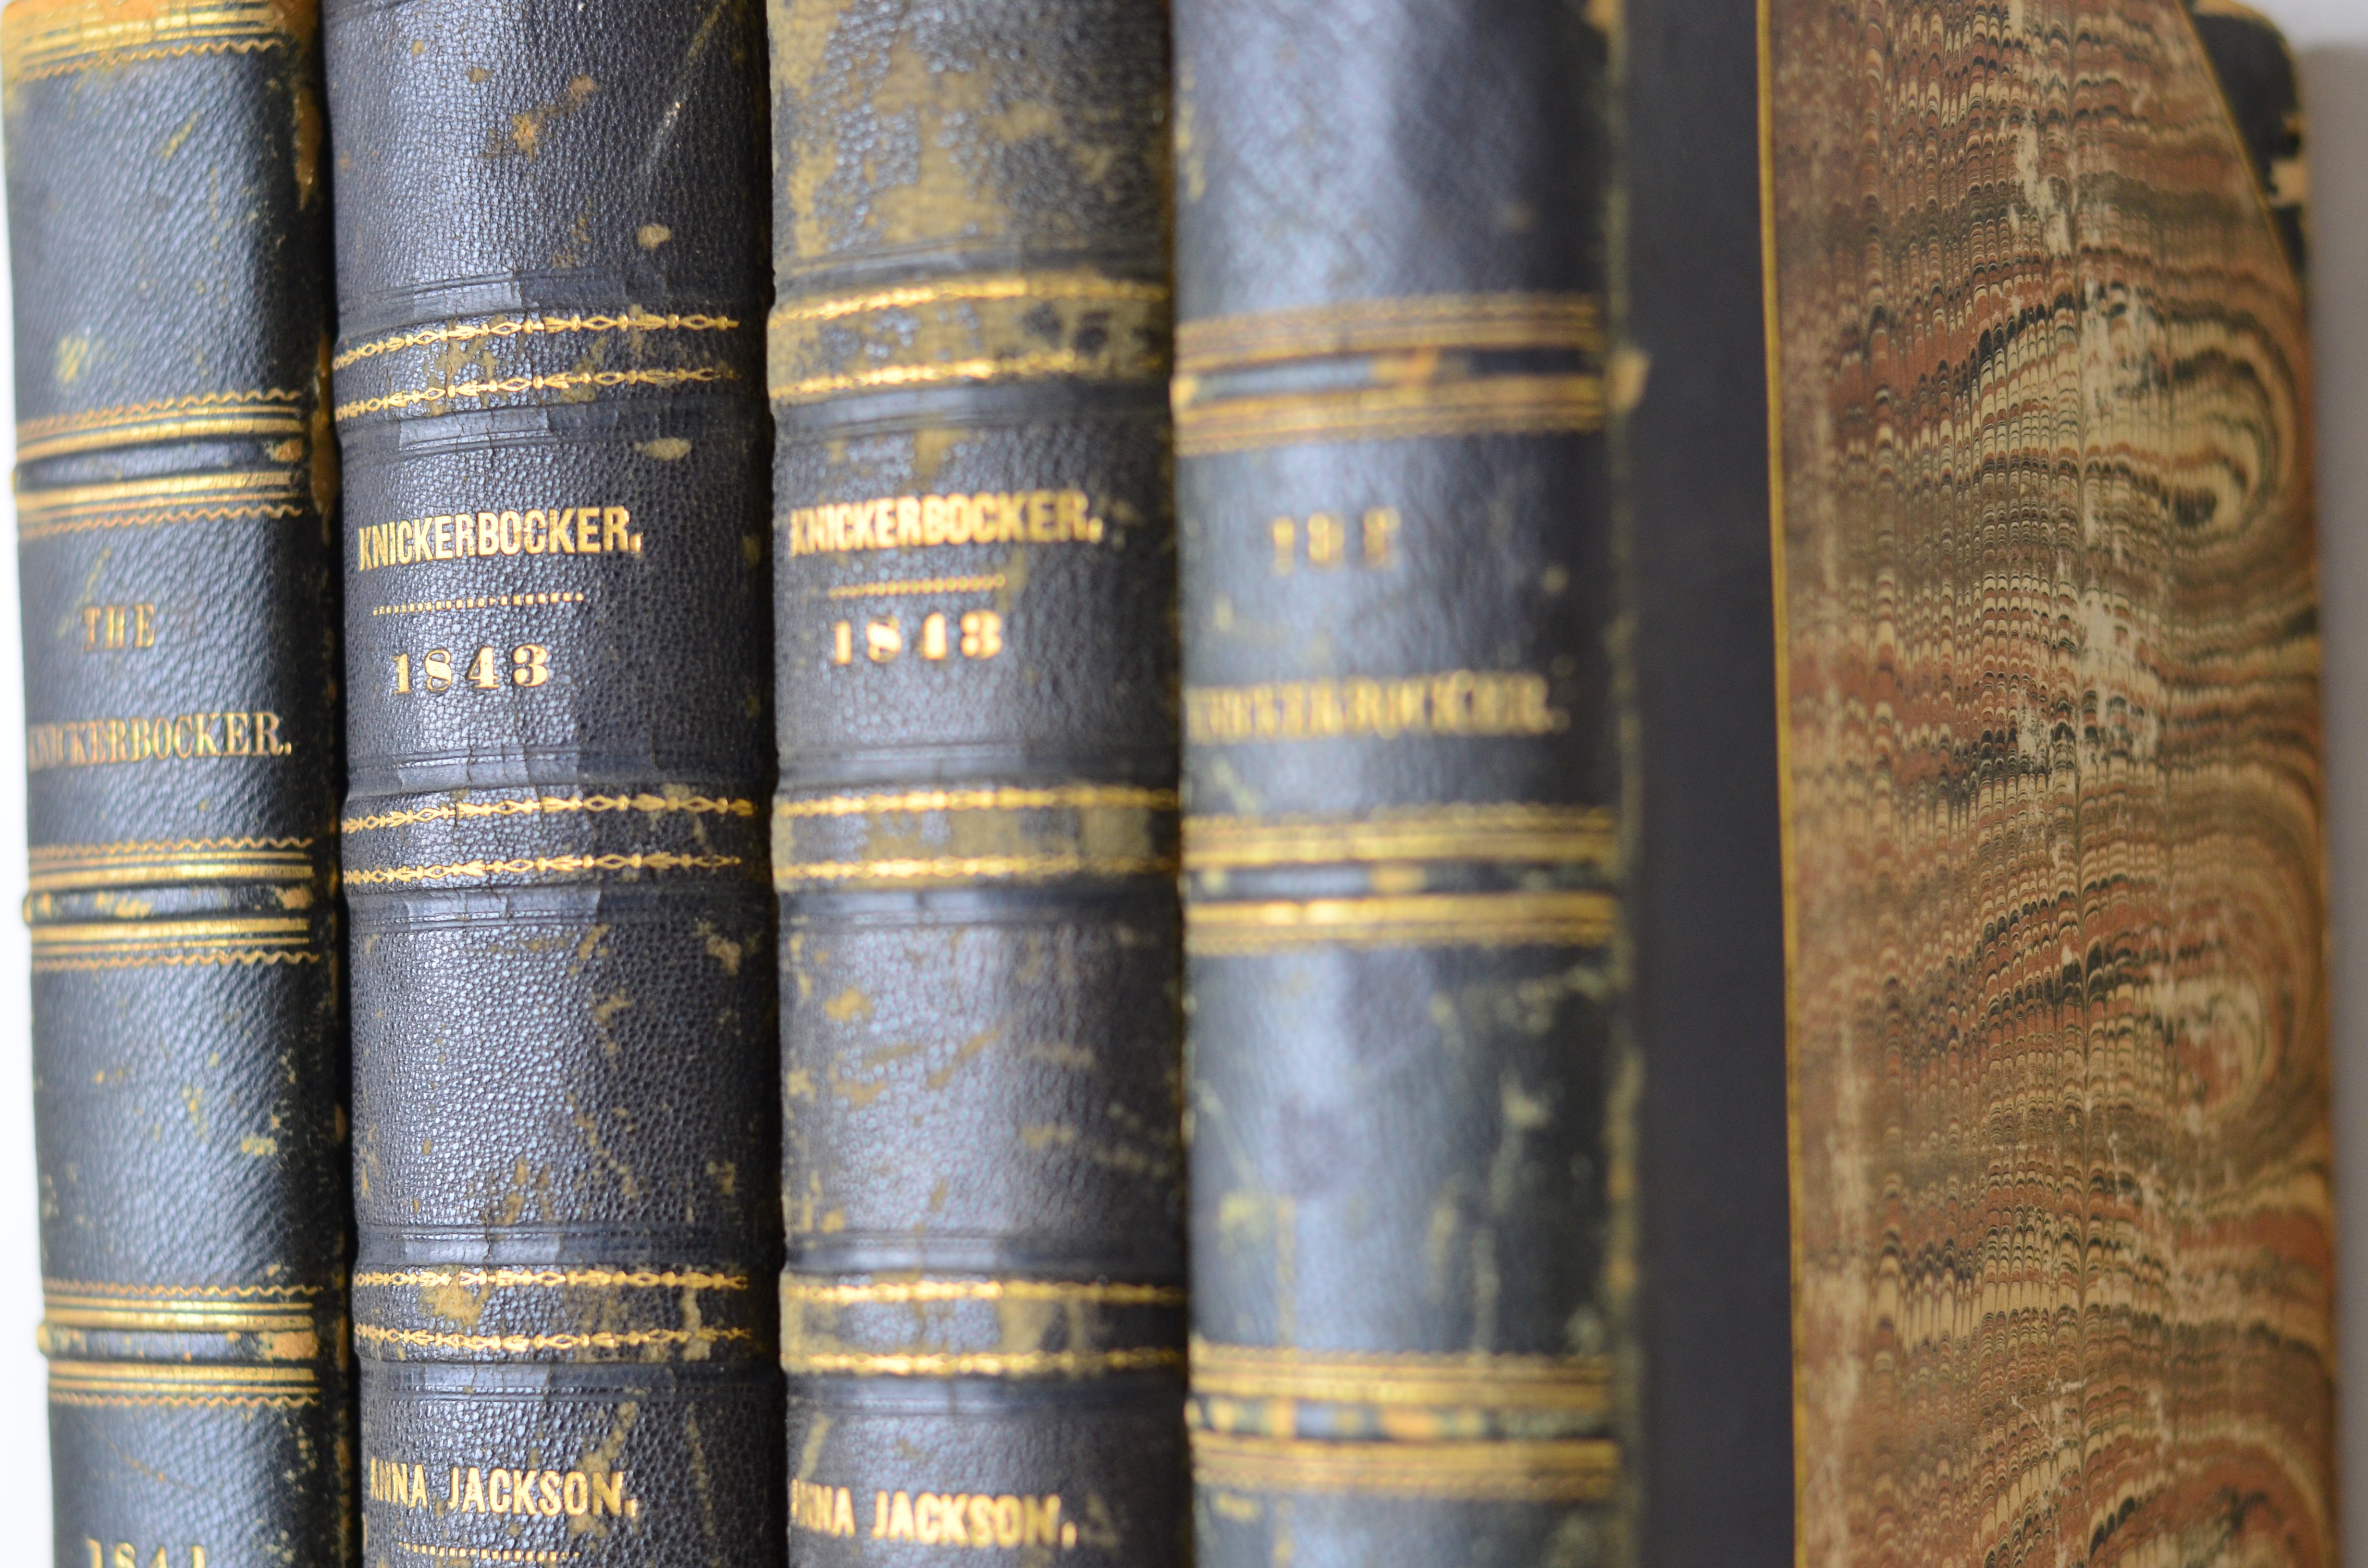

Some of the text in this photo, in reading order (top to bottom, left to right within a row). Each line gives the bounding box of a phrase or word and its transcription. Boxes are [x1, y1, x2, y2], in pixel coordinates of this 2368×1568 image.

[359, 506, 643, 572] KNICKERBOCKER.
[82, 602, 156, 652] THE
[391, 644, 549, 696] 1843
[447, 1466, 638, 1518] JACKSON.
[870, 1490, 1077, 1551] JACKSON.
